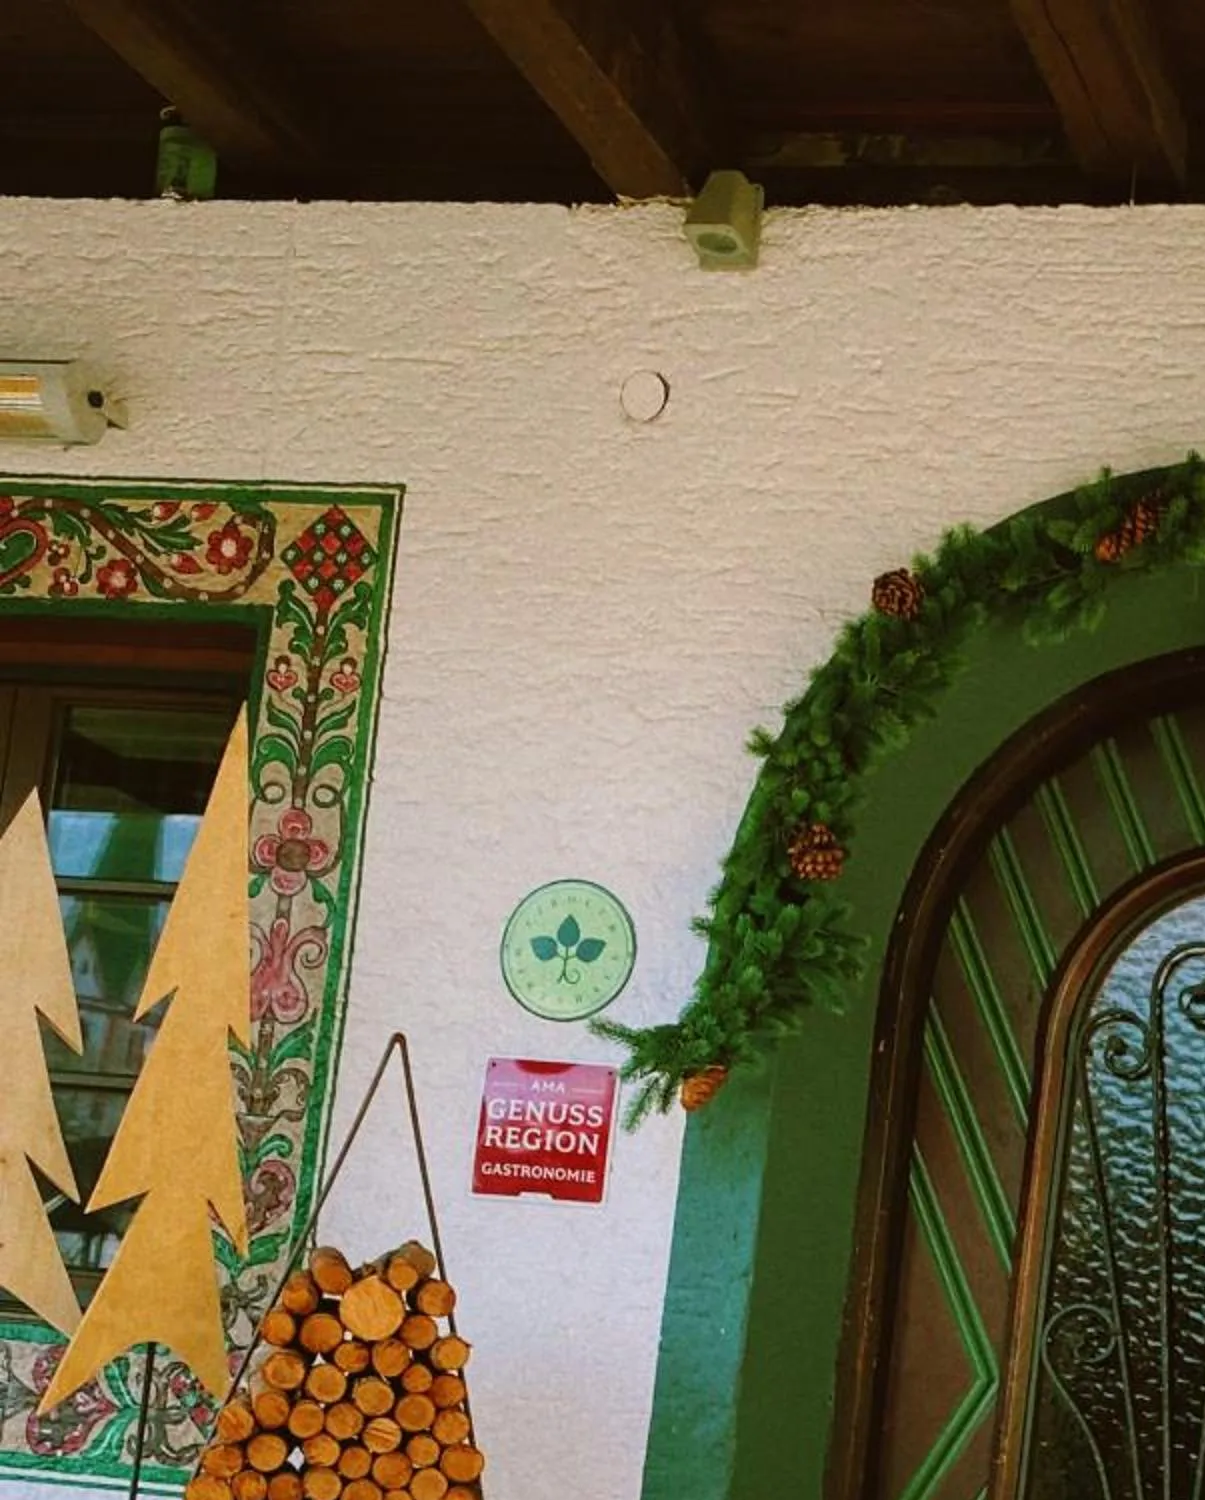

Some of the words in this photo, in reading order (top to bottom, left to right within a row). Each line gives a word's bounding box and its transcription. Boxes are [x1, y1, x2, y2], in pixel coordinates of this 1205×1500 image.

[529, 1081, 566, 1095] AMA
[486, 1098, 604, 1129] GENUSS
[483, 1126, 600, 1156] REGION
[480, 1161, 597, 1184] GASTRONOMIE
